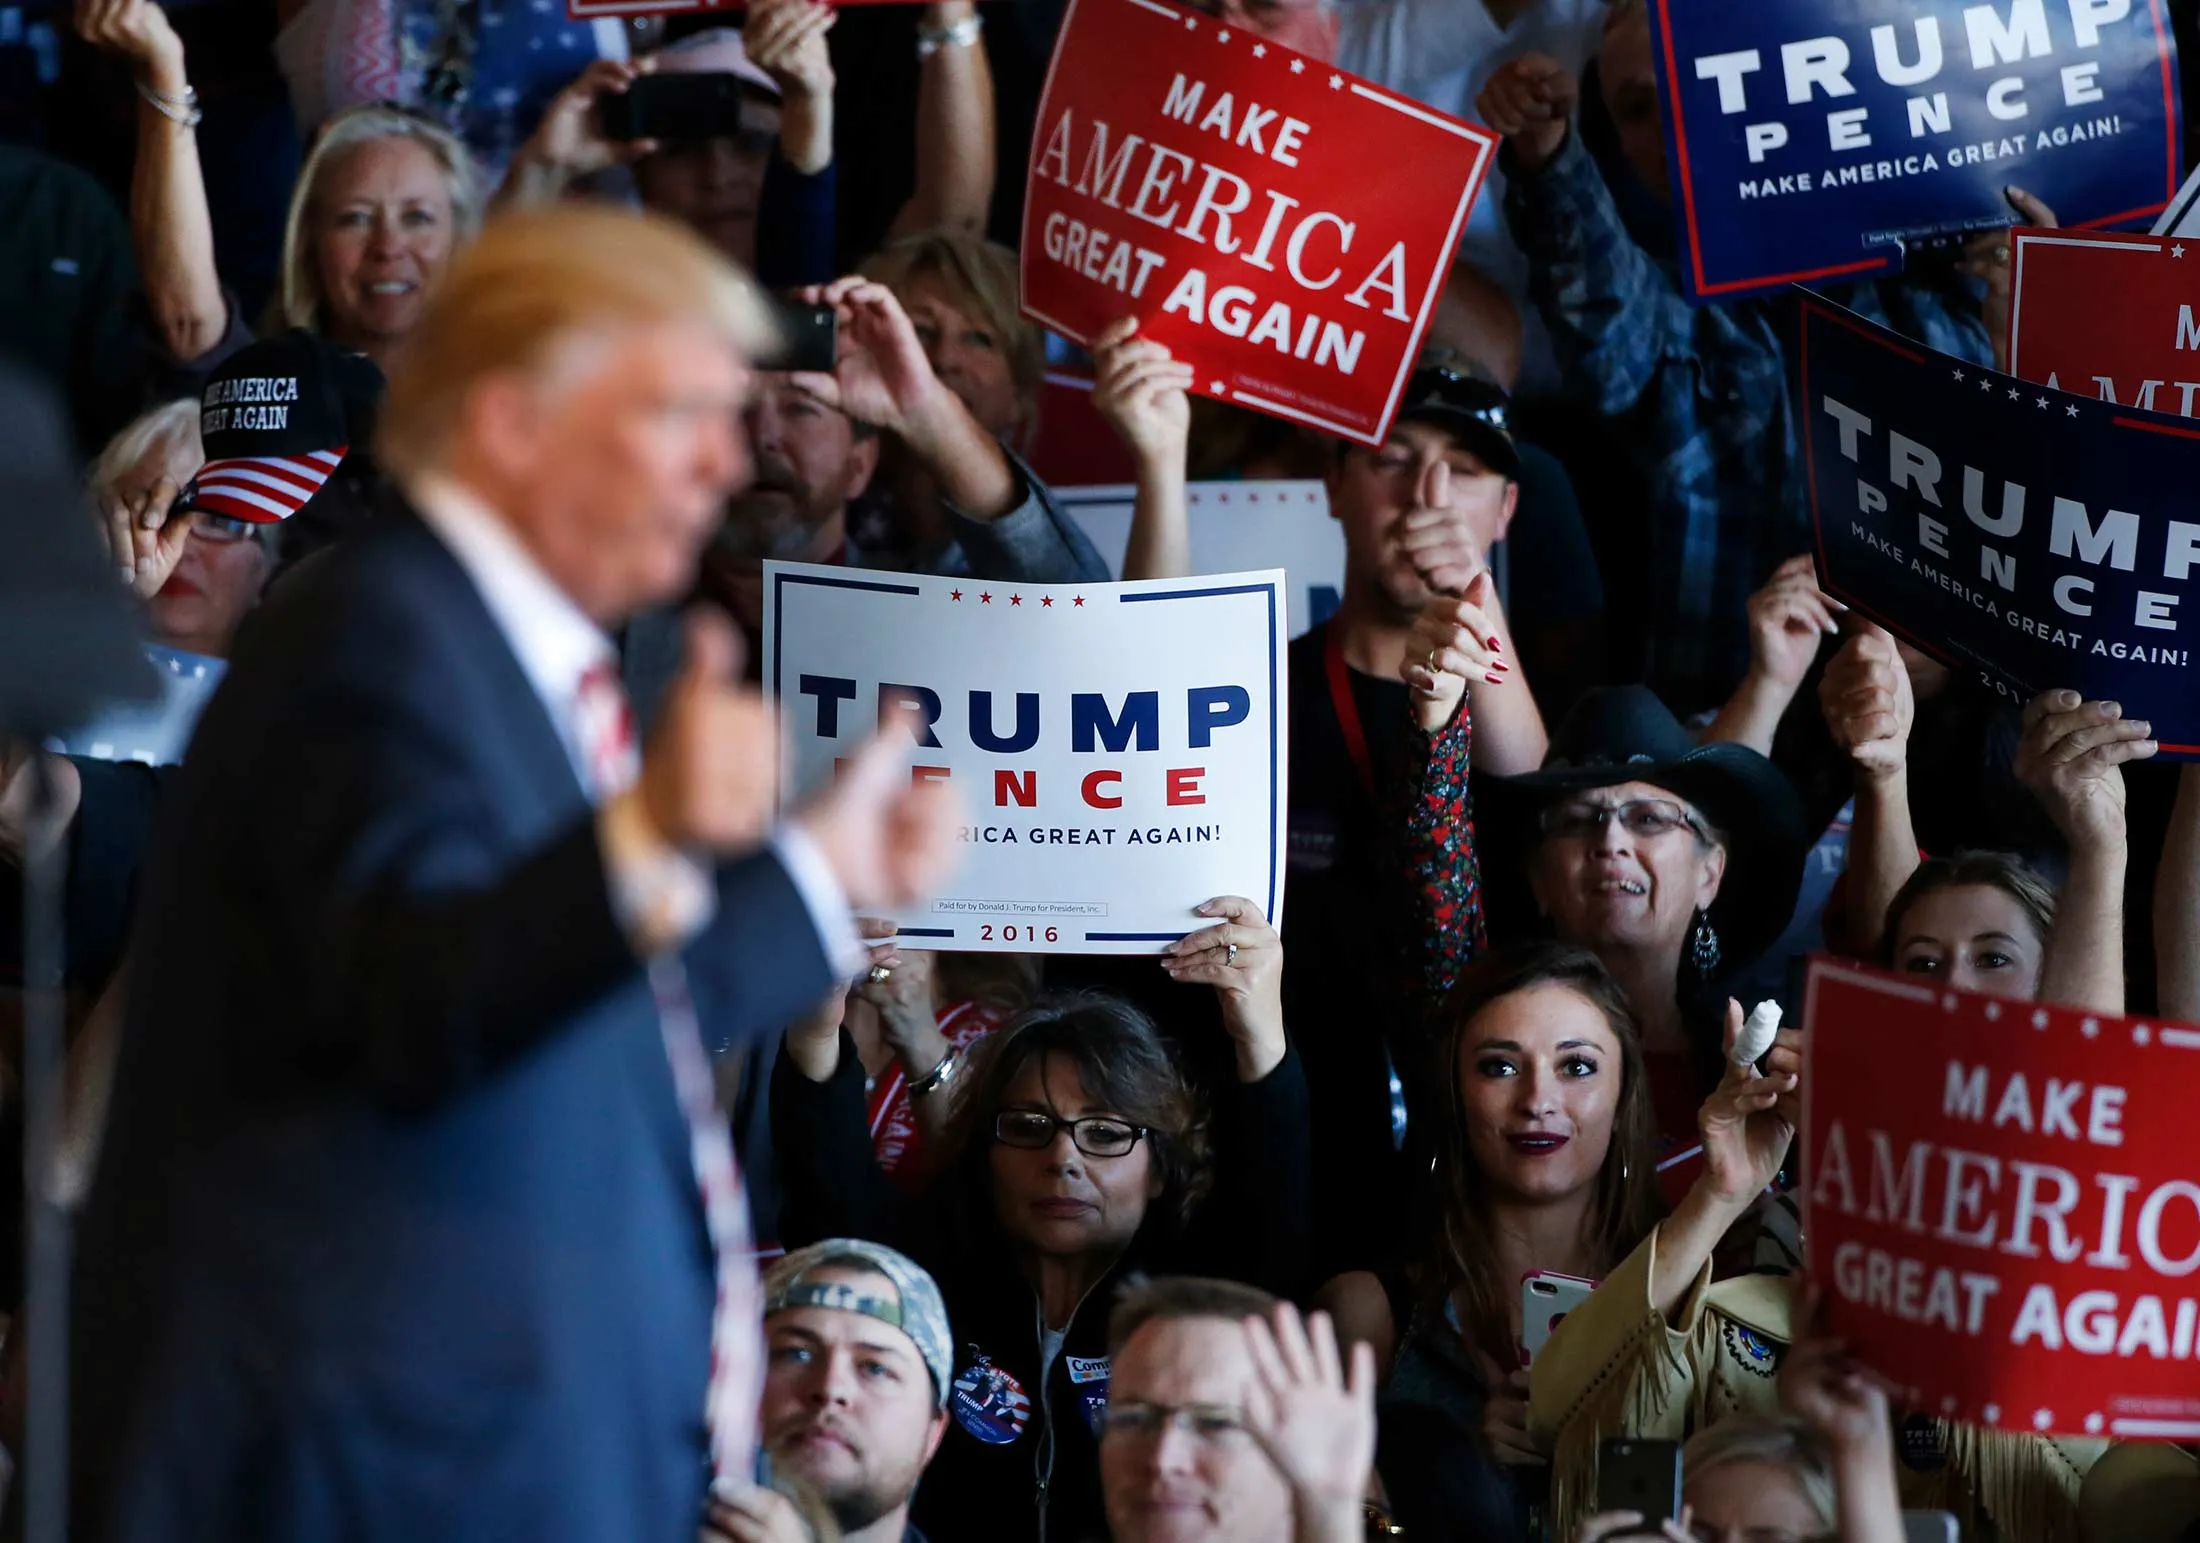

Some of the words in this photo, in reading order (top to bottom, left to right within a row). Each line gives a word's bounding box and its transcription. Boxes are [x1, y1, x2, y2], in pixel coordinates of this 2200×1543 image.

[1694, 0, 2131, 114] TRUMP
[1161, 72, 1311, 168] MAKE
[1745, 62, 2104, 163] PENCE
[1739, 173, 1812, 200] MAKE
[1821, 157, 1939, 188] AMERICA
[1948, 136, 2026, 168] GREAT
[2036, 116, 2122, 151] AGAIN!
[1035, 107, 1412, 323] AMERICA
[1044, 211, 1166, 298] GREAT
[1162, 267, 1366, 375] AGAIN
[221, 377, 299, 402] AMERICA
[231, 406, 289, 430] AGAIN
[1851, 520, 1904, 564] MAKE
[1911, 553, 1999, 618] AMERICA
[2007, 609, 2082, 650] GREAT
[2090, 638, 2188, 667] AGAIN!
[1857, 478, 2180, 631] PENCE
[799, 674, 1250, 753] TRUMP
[1980, 671, 2030, 705] 201
[1029, 828, 1116, 845] GREAT
[1127, 825, 1221, 845] AGAIN!
[939, 902, 955, 910] Paid
[956, 902, 967, 910] for
[968, 902, 977, 911] by
[978, 903, 1004, 911] Donald
[1013, 904, 1036, 913] Trump
[1037, 904, 1048, 912] for
[1050, 904, 1085, 914] President,
[980, 924, 1058, 942] 2016
[1942, 1060, 2127, 1147] MAKE
[1833, 1241, 1999, 1337] GREAT
[2009, 1283, 2200, 1361] AGAI
[957, 1390, 984, 1412] TRUMP
